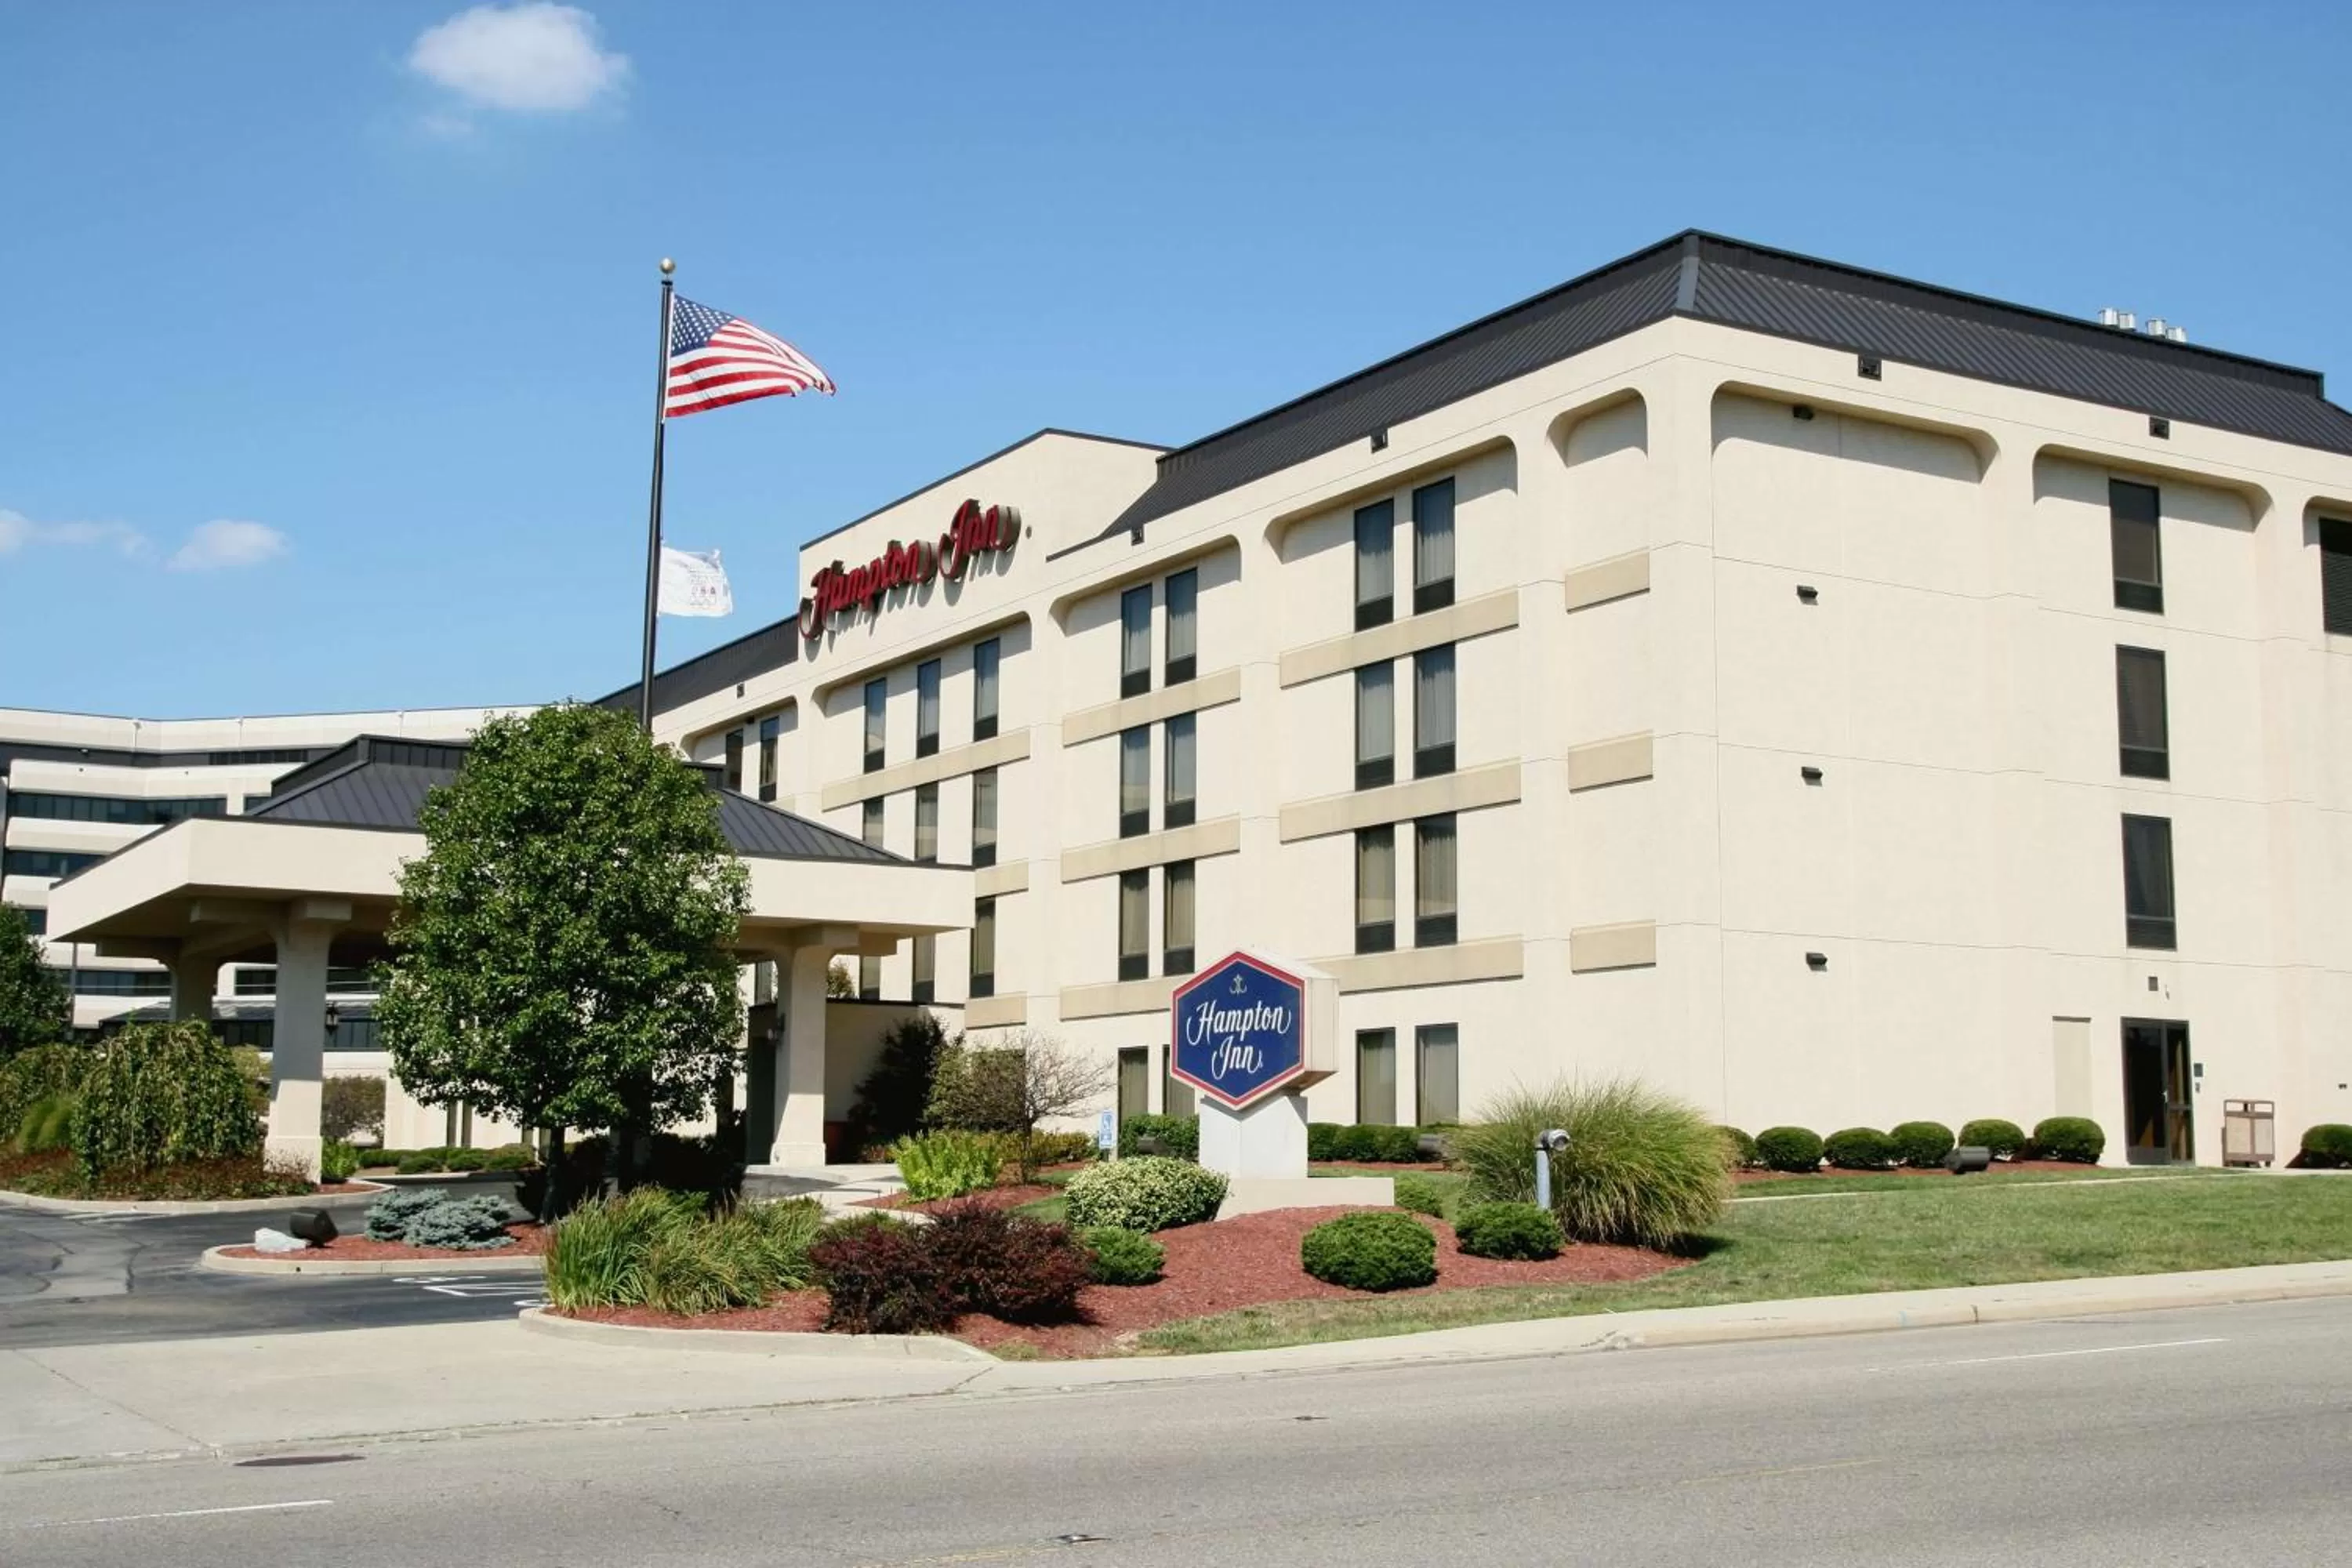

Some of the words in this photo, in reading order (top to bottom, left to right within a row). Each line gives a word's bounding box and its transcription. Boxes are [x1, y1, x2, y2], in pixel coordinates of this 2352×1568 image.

[799, 539, 937, 640] Hampton
[939, 499, 1020, 579] Inn
[1186, 1000, 1291, 1046] Hampton
[1211, 1036, 1262, 1080] Inn
